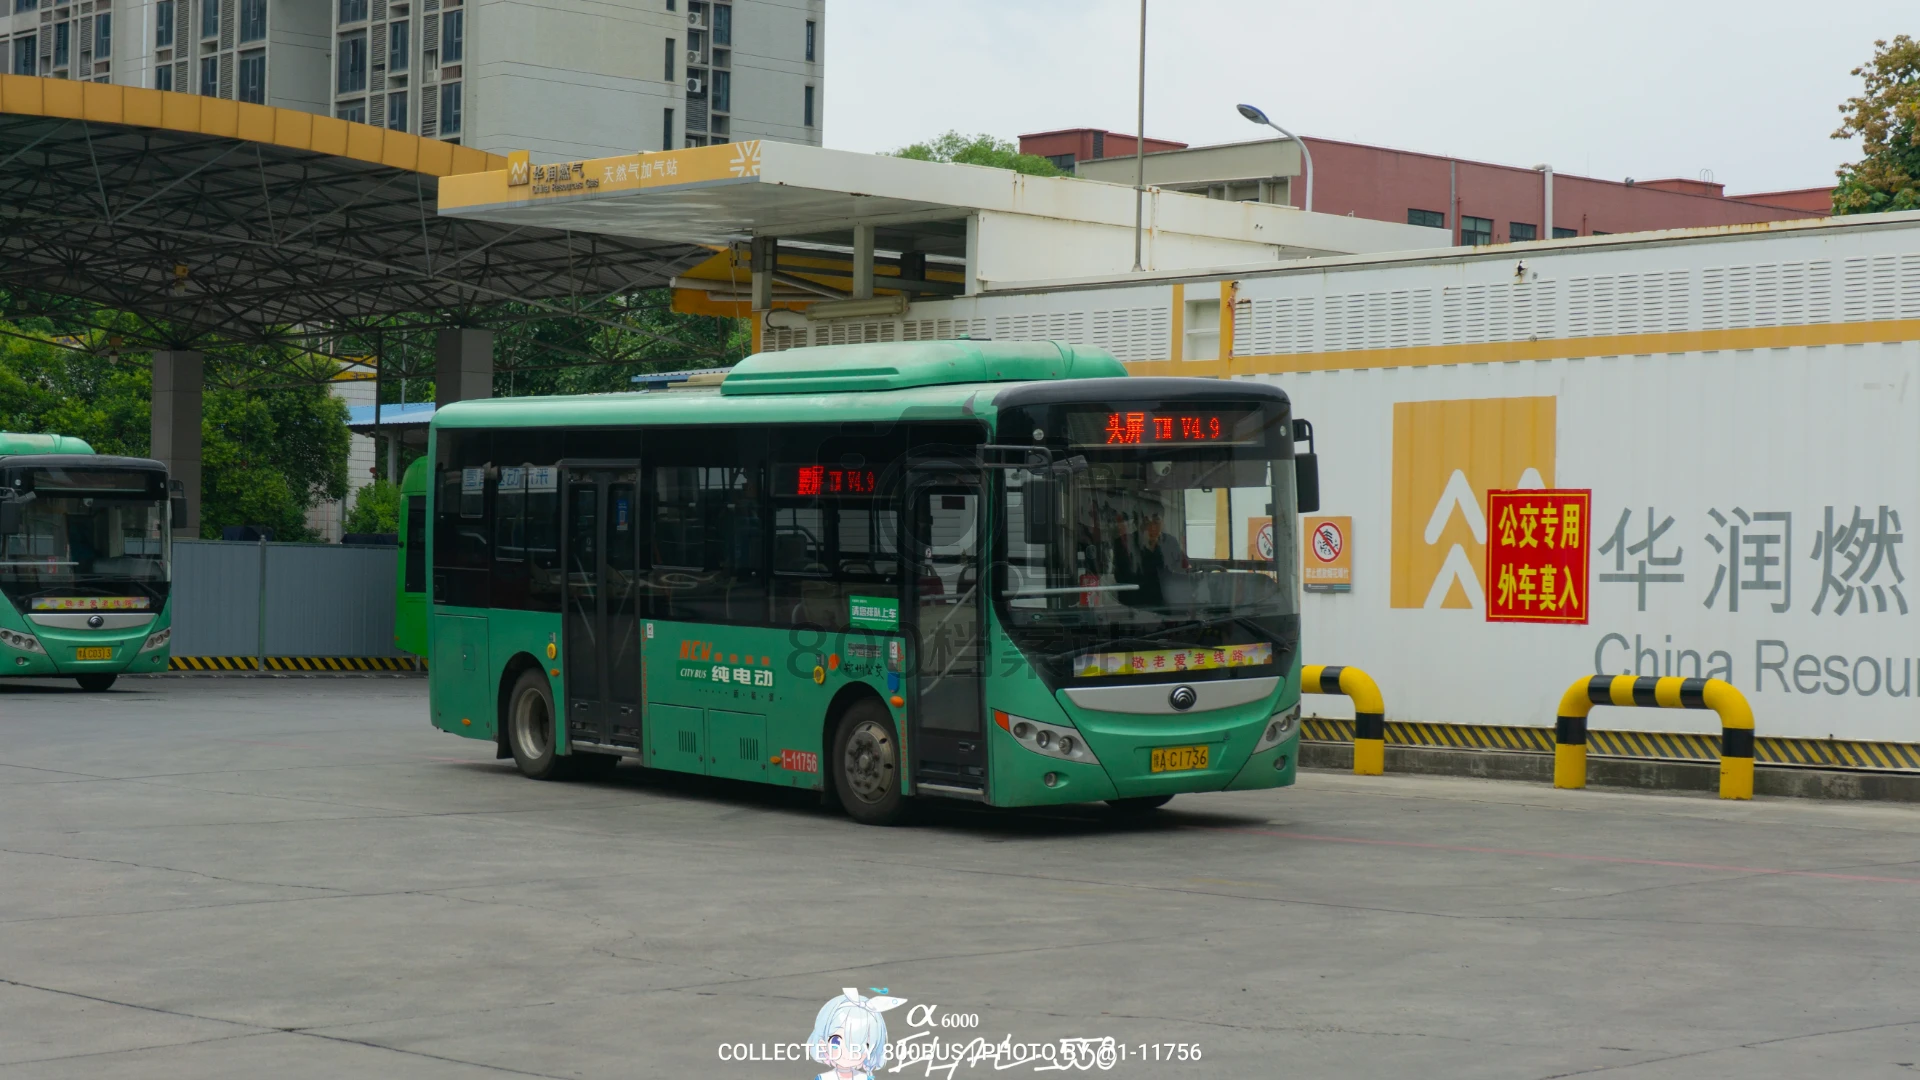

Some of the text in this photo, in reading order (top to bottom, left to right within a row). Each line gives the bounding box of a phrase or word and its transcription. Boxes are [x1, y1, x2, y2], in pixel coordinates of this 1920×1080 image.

[533, 162, 585, 183] 华润燃气
[604, 159, 679, 184] 天然气加气站
[1105, 412, 1145, 444] 头屏
[1181, 417, 1220, 439] V4.9
[1498, 502, 1580, 549] 公交专用
[1598, 505, 1909, 617] 华润燃
[1497, 563, 1579, 611] 外车莫入
[843, 661, 884, 680] 郑州公交
[1132, 650, 1244, 669] 敬老爱老线路
[1594, 632, 1920, 698] China Resou
[680, 667, 707, 679] CITY BUS
[711, 665, 773, 687] 纯电动
[781, 751, 818, 773] 1-11756
